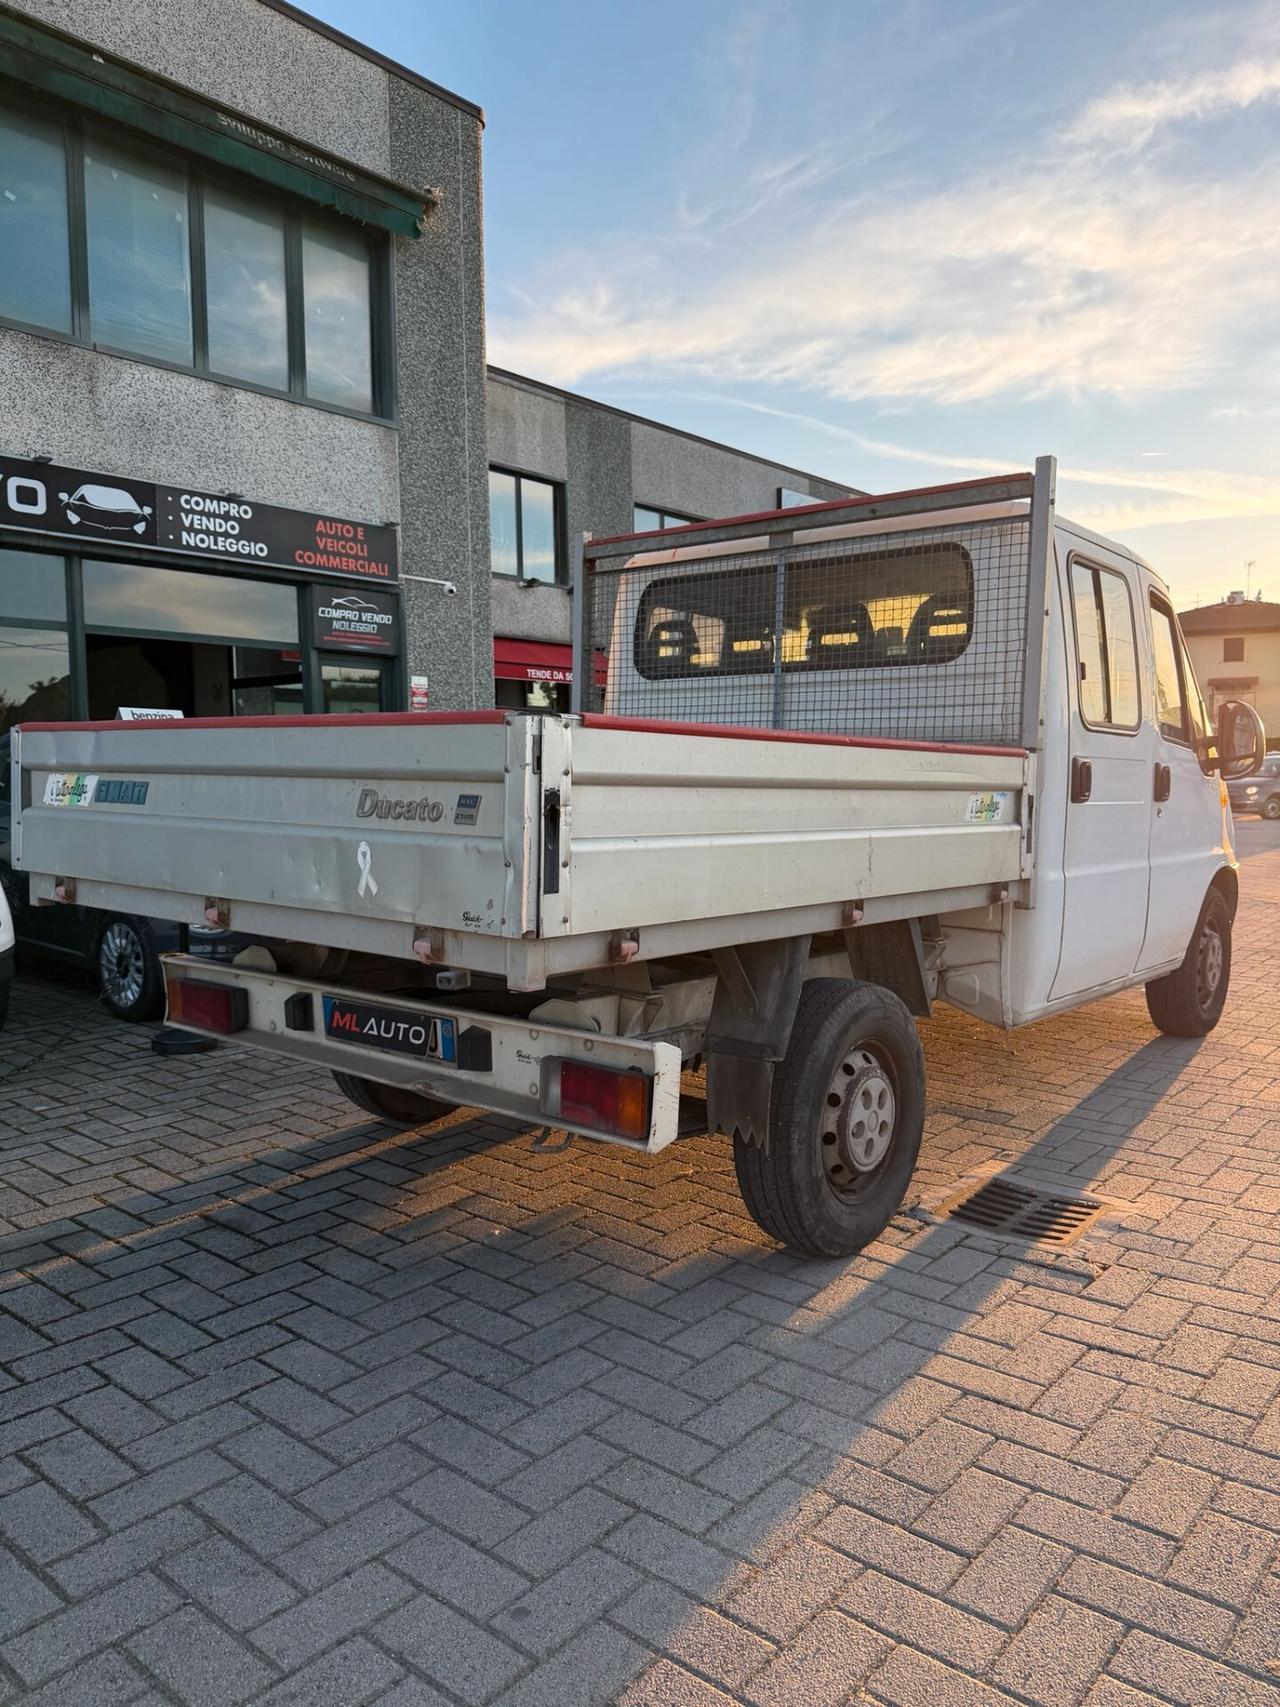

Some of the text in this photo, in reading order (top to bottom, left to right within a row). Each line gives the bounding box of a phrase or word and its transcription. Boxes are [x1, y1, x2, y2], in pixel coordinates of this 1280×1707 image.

[180, 494, 253, 520] COMPRO
[181, 512, 240, 536] VENDO
[315, 519, 365, 540] AUTO E
[181, 531, 269, 558] NOLEGGIO
[316, 536, 368, 557] VEICOLI
[295, 549, 389, 577] COMMERCIALI
[318, 607, 393, 624] COMPRO VENDO
[332, 620, 378, 633] NOLEGGIO
[526, 668, 552, 680] TENDE
[553, 670, 564, 681] DA
[130, 709, 175, 720] benzina
[356, 788, 444, 822] Ducato
[331, 1010, 361, 1033] ML
[362, 1017, 426, 1045] AUTO
